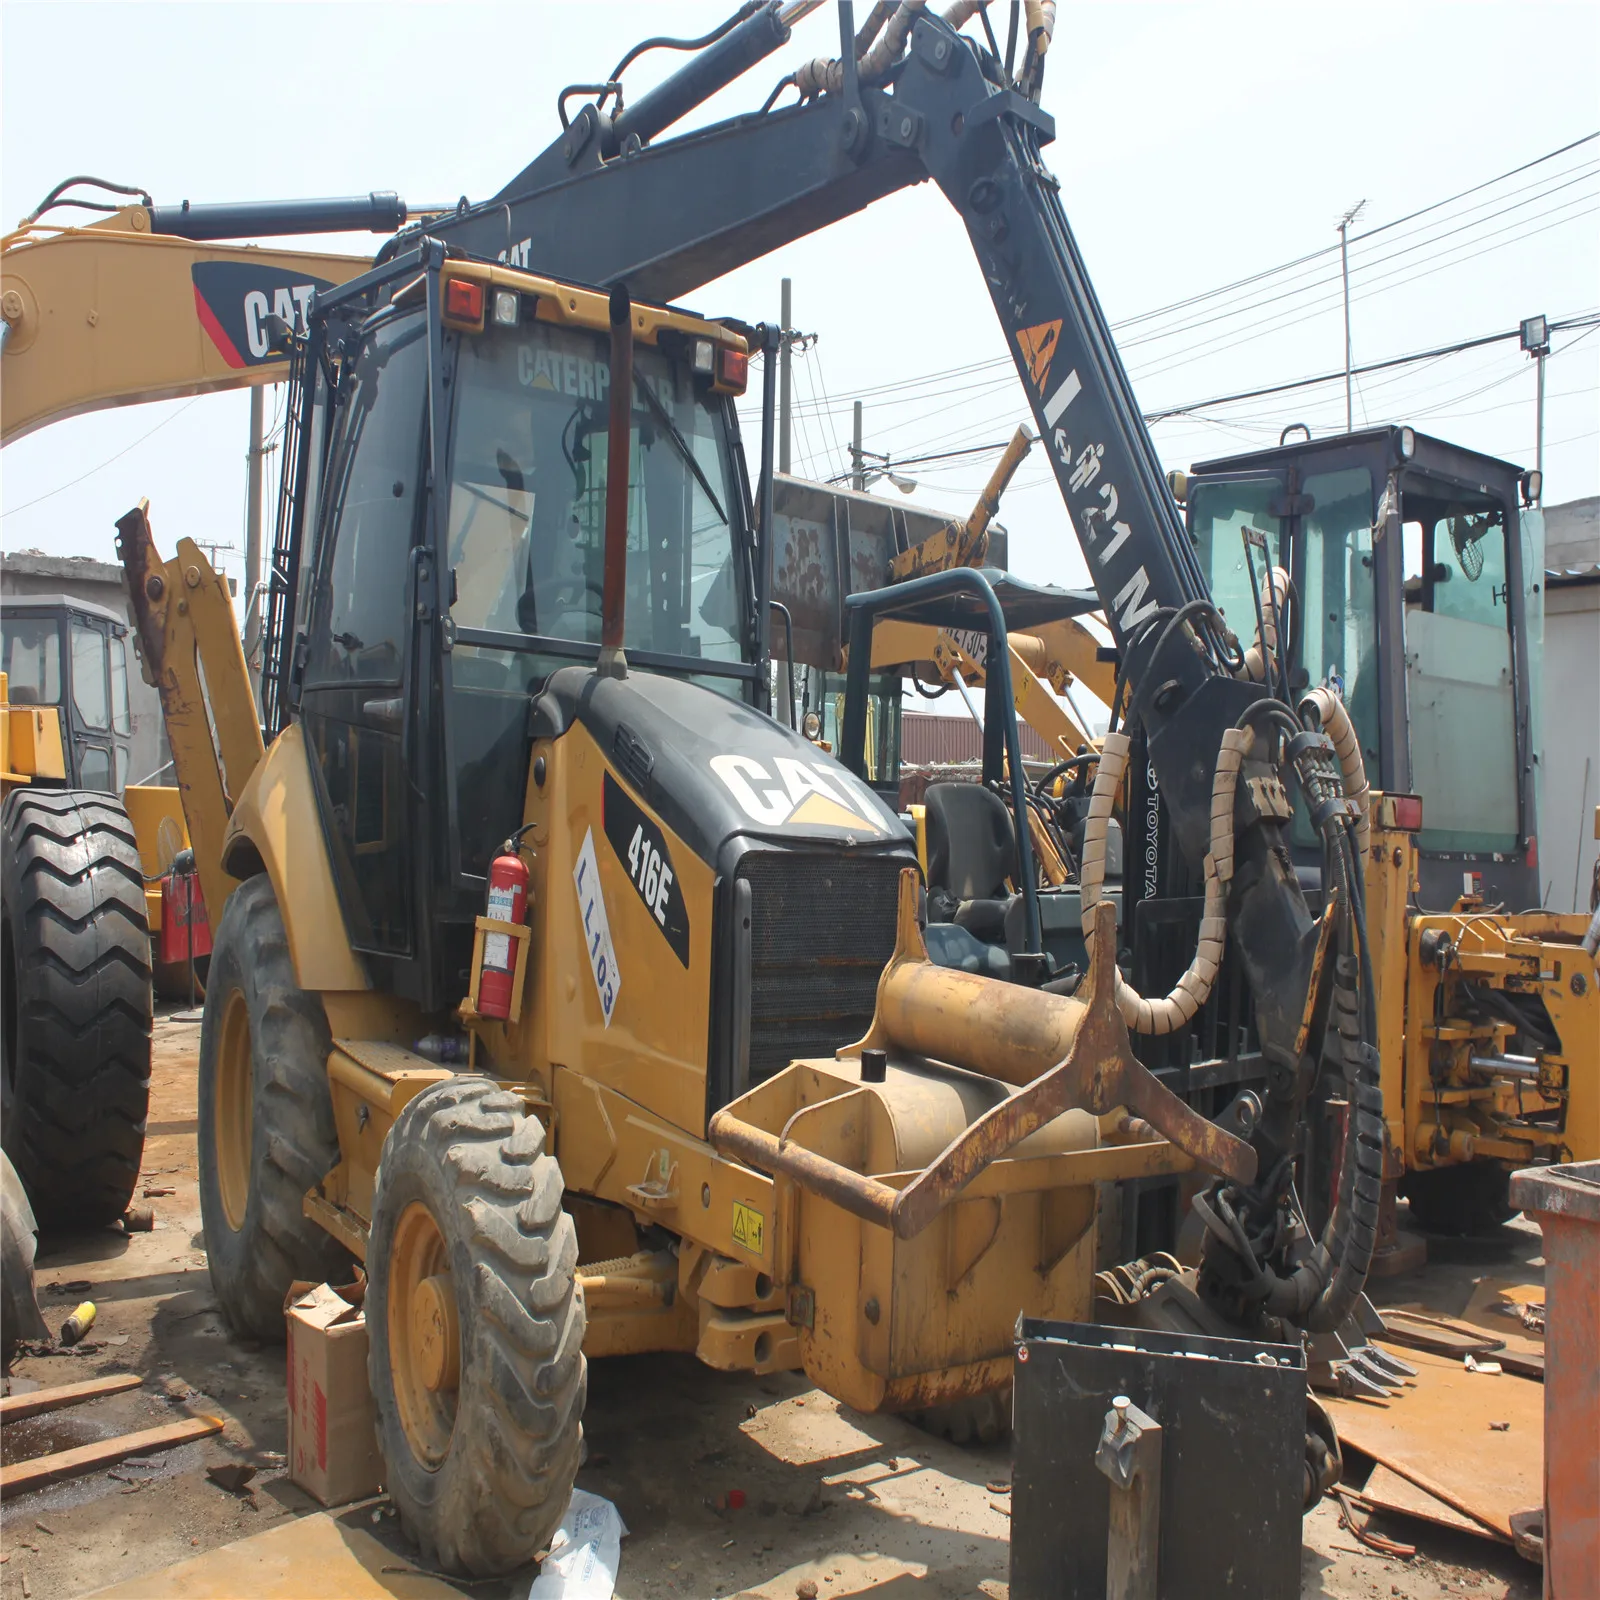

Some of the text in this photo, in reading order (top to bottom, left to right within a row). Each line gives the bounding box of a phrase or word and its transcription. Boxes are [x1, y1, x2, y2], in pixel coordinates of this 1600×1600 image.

[517, 345, 675, 419] CATERPLAR
[709, 754, 893, 835] CAT
[628, 824, 673, 927] 416E
[1144, 793, 1159, 899] TOYOTA
